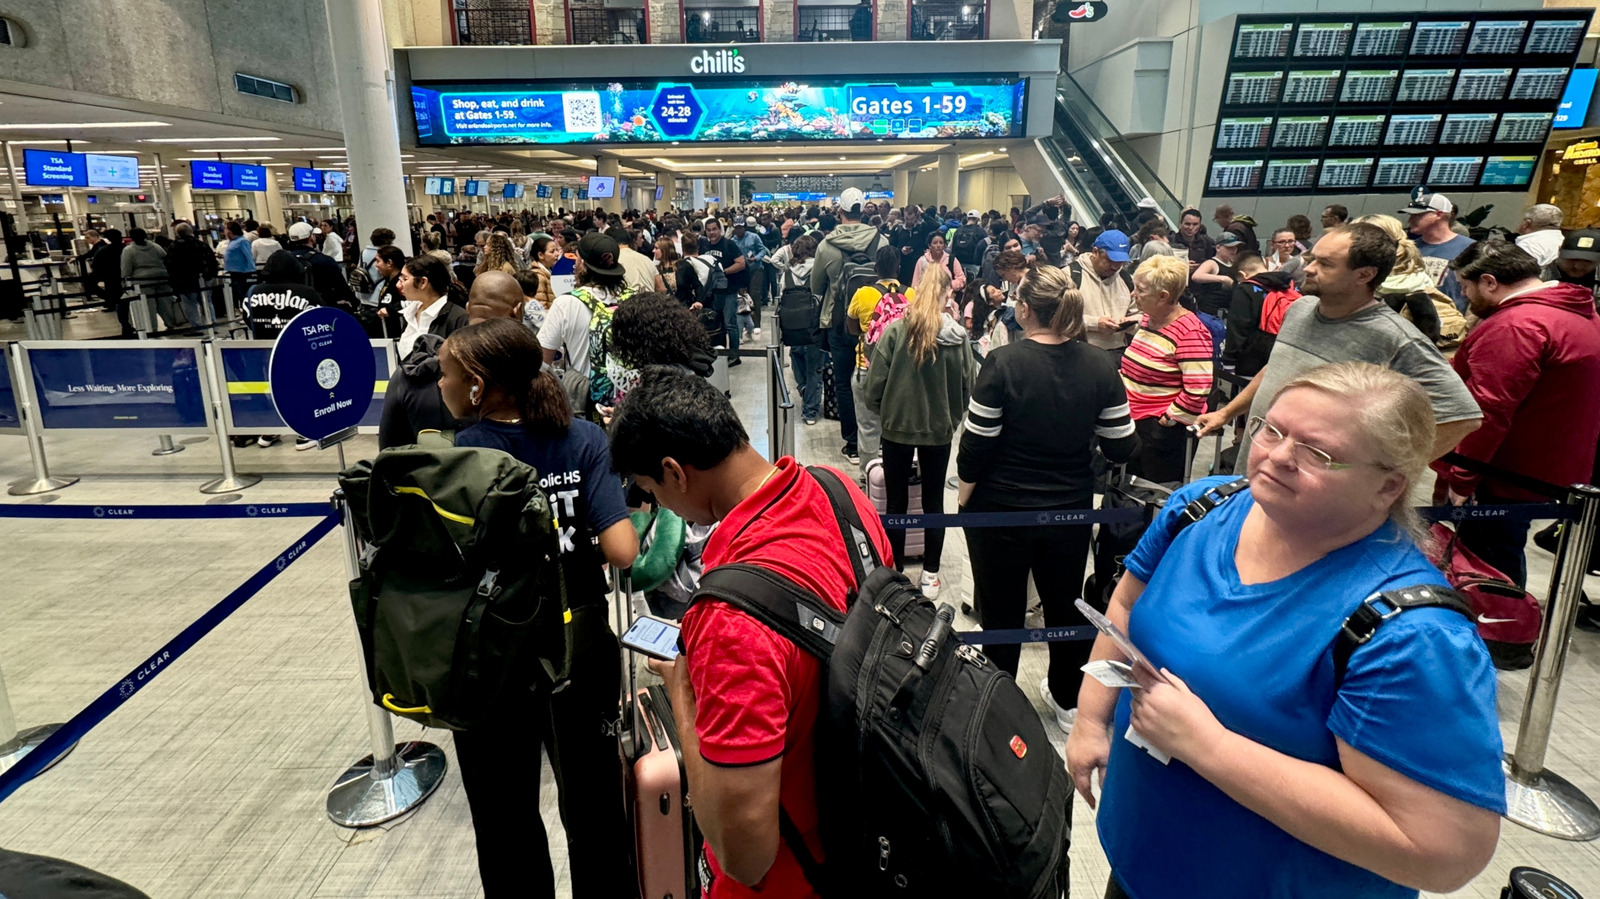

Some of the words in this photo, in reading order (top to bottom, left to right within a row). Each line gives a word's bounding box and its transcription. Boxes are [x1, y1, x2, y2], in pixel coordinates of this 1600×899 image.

[691, 48, 746, 74] chili's
[452, 99, 479, 110] Shop,
[481, 99, 499, 109] eat,
[501, 98, 519, 108] and
[520, 97, 545, 107] drink
[852, 96, 913, 115] Gates
[922, 95, 967, 114] 1-59
[454, 111, 465, 120] at
[466, 110, 493, 120] Gates
[495, 110, 517, 119] 1-59.
[661, 106, 692, 117] 24-28
[42, 173, 74, 181] Screening
[302, 325, 317, 336] TSA
[317, 323, 330, 333] Pre
[68, 384, 85, 392] Less
[85, 384, 116, 394] Waiting,
[116, 384, 136, 392] More
[314, 403, 336, 418] Enroll
[336, 398, 353, 410] Now
[540, 473, 561, 488] olic
[563, 470, 581, 484] HS
[107, 508, 134, 516] CLEAR
[260, 507, 288, 515] CLEAR
[1471, 509, 1509, 517] CLEAR
[1055, 513, 1087, 522] CLEAR
[287, 540, 307, 560] CLEAR
[1047, 629, 1077, 638] CLEAR
[137, 650, 170, 682] CLEAR
